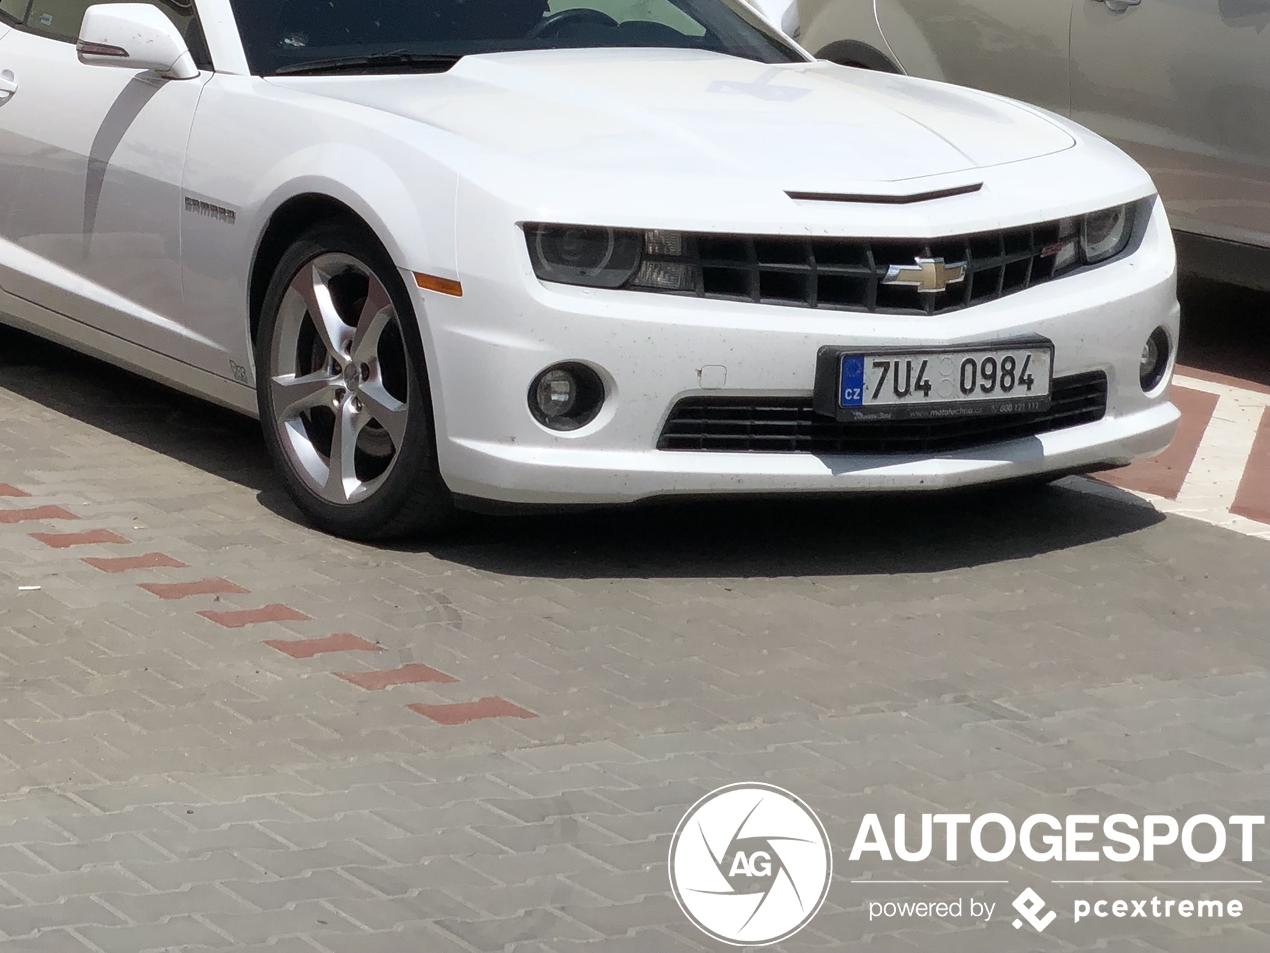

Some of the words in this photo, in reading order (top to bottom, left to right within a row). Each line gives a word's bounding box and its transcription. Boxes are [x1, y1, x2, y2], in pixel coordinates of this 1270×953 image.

[871, 359, 932, 400] 7U4
[959, 354, 1035, 395] 0984
[844, 388, 861, 400] CZ
